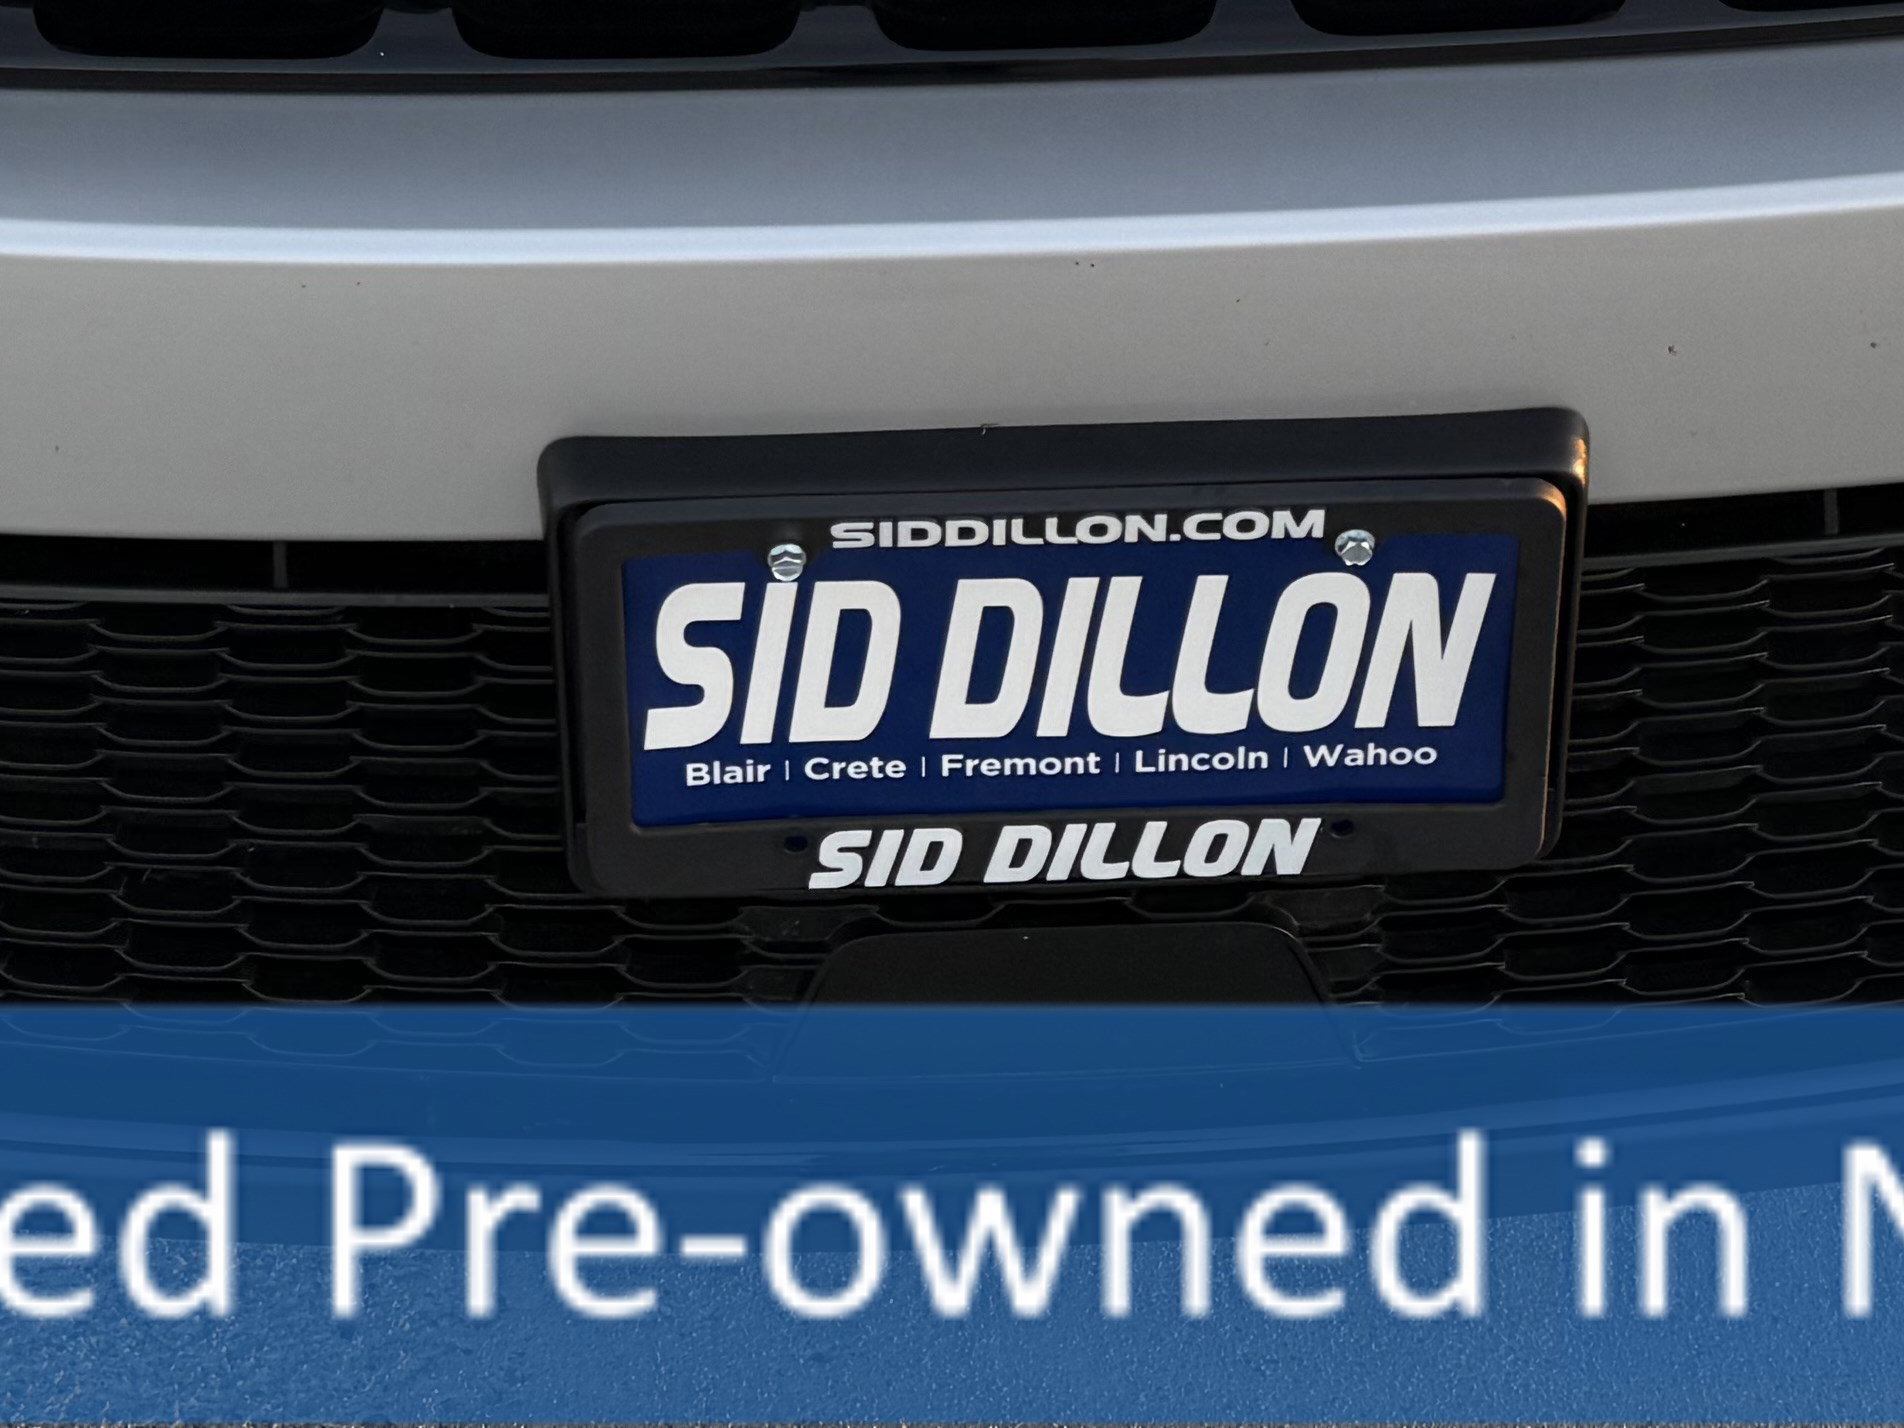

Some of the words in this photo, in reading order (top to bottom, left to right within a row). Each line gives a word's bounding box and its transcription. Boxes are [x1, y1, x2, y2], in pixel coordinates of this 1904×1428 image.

[829, 508, 1327, 550] SIDDILLON.COM
[642, 578, 903, 752] SID
[928, 570, 1498, 741] DILLON
[684, 757, 772, 788] Blair
[803, 755, 908, 781] Crete
[939, 751, 1102, 779] Fremont
[1133, 744, 1270, 775] Lincoln
[1302, 741, 1439, 770] Wahoo
[807, 826, 964, 891] SID
[981, 816, 1323, 885] DILLON
